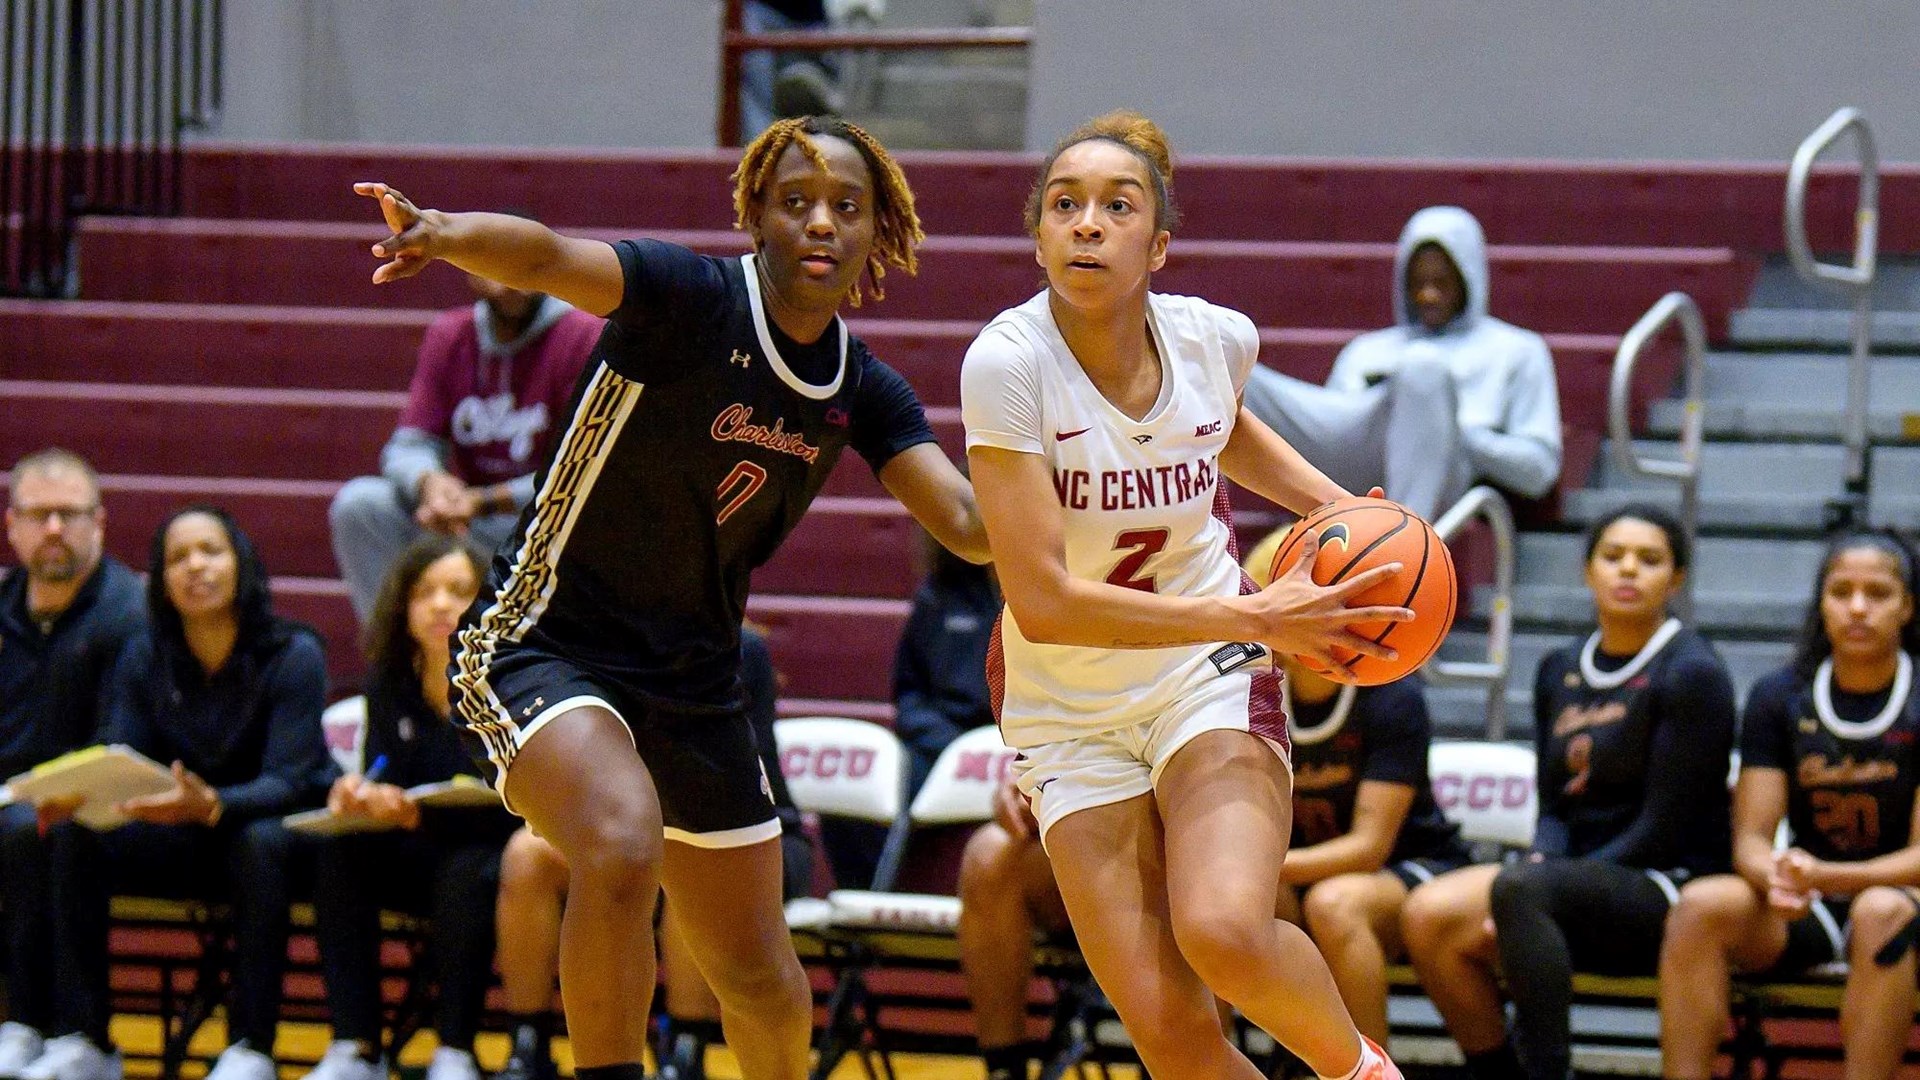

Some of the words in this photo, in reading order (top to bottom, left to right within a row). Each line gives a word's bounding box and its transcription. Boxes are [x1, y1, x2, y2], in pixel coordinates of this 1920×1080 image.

[1194, 420, 1221, 437] MEAC
[1053, 467, 1089, 510] NC
[1101, 455, 1216, 511] CENTRAL
[1103, 526, 1171, 594] 2
